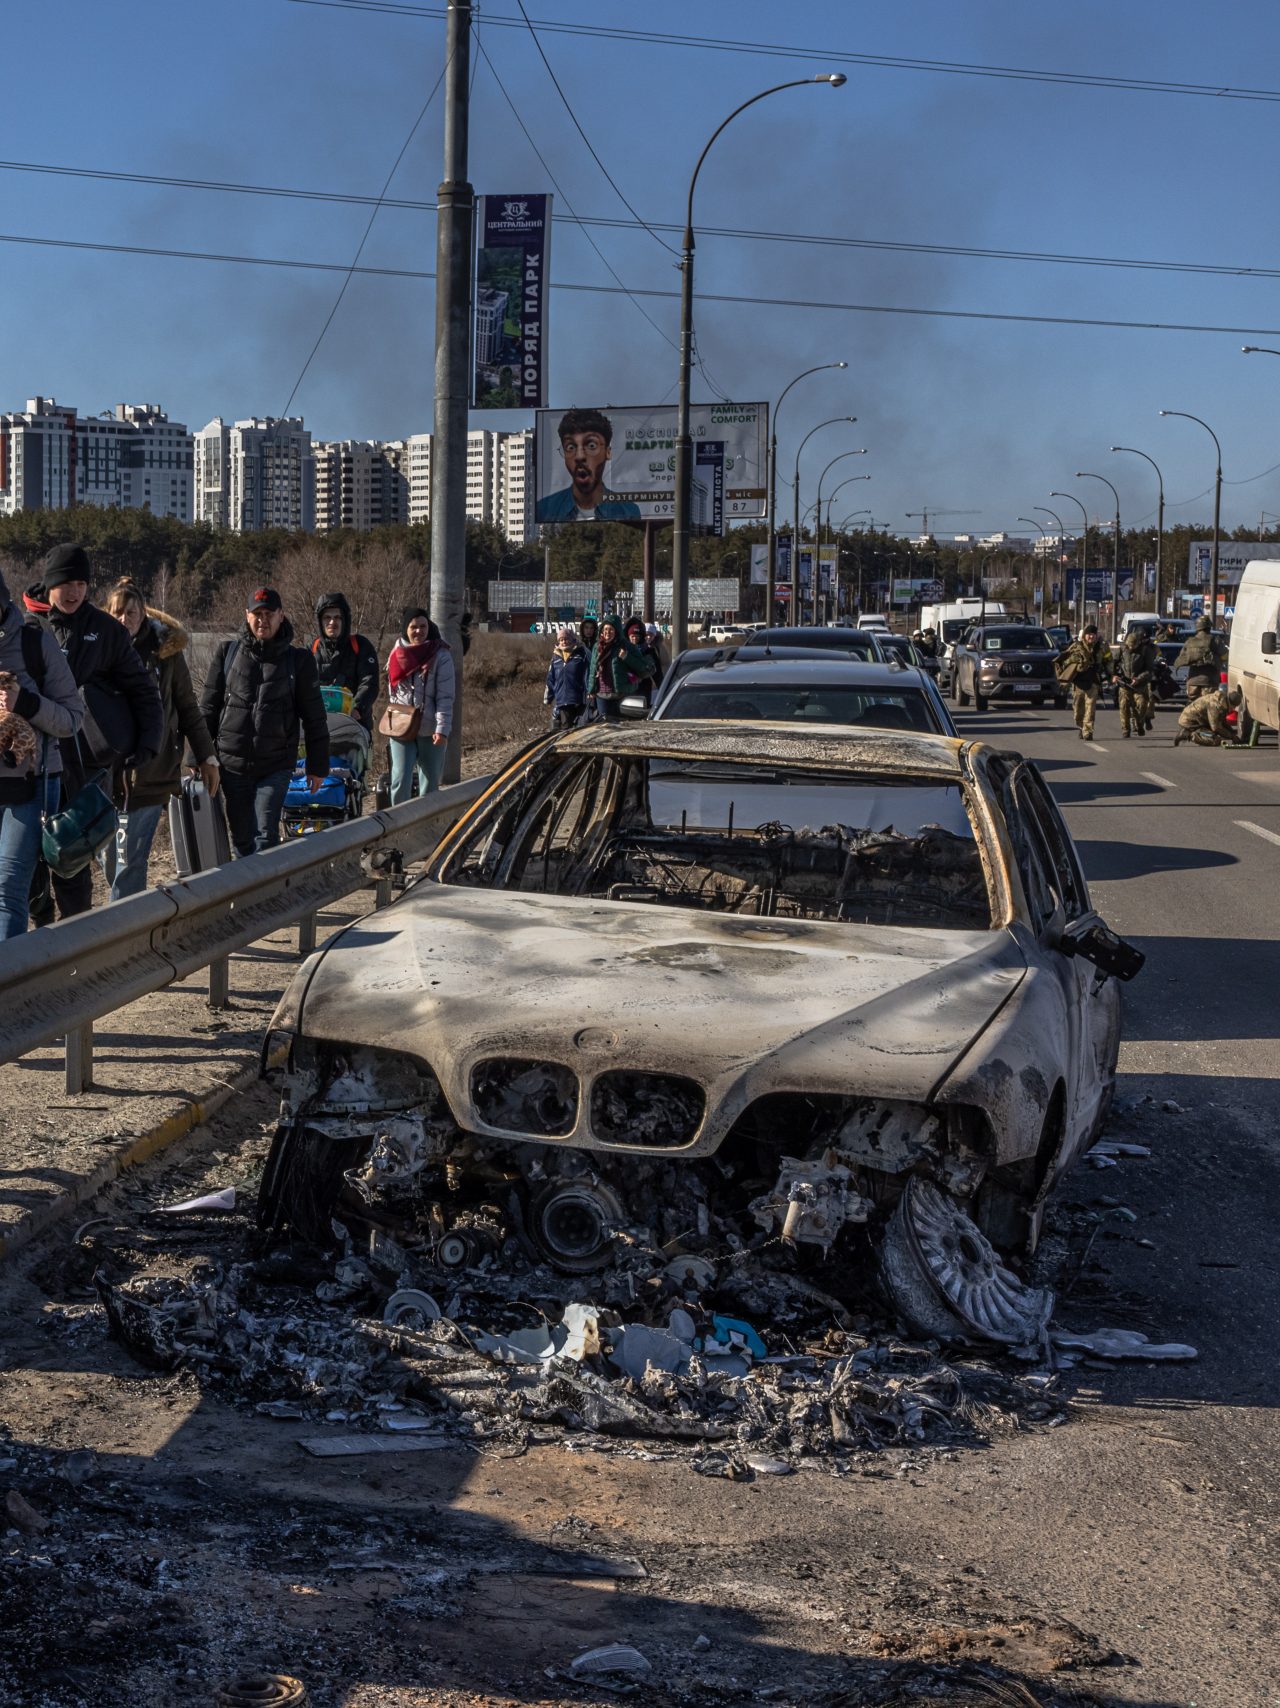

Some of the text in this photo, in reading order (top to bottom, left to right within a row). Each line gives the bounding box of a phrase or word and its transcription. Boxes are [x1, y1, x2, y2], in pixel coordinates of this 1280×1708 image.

[487, 219, 543, 229] ЦЕНТРАЛЬНИЙ
[524, 254, 540, 397] ПОРЯД ПАРК
[711, 406, 744, 415] FAMILY
[711, 415, 757, 424] COMFORT
[625, 426, 706, 439] ПОСПІАЙ
[625, 440, 674, 450] КВАРТИ
[714, 465, 722, 534] ЦЕНТР МІСТА
